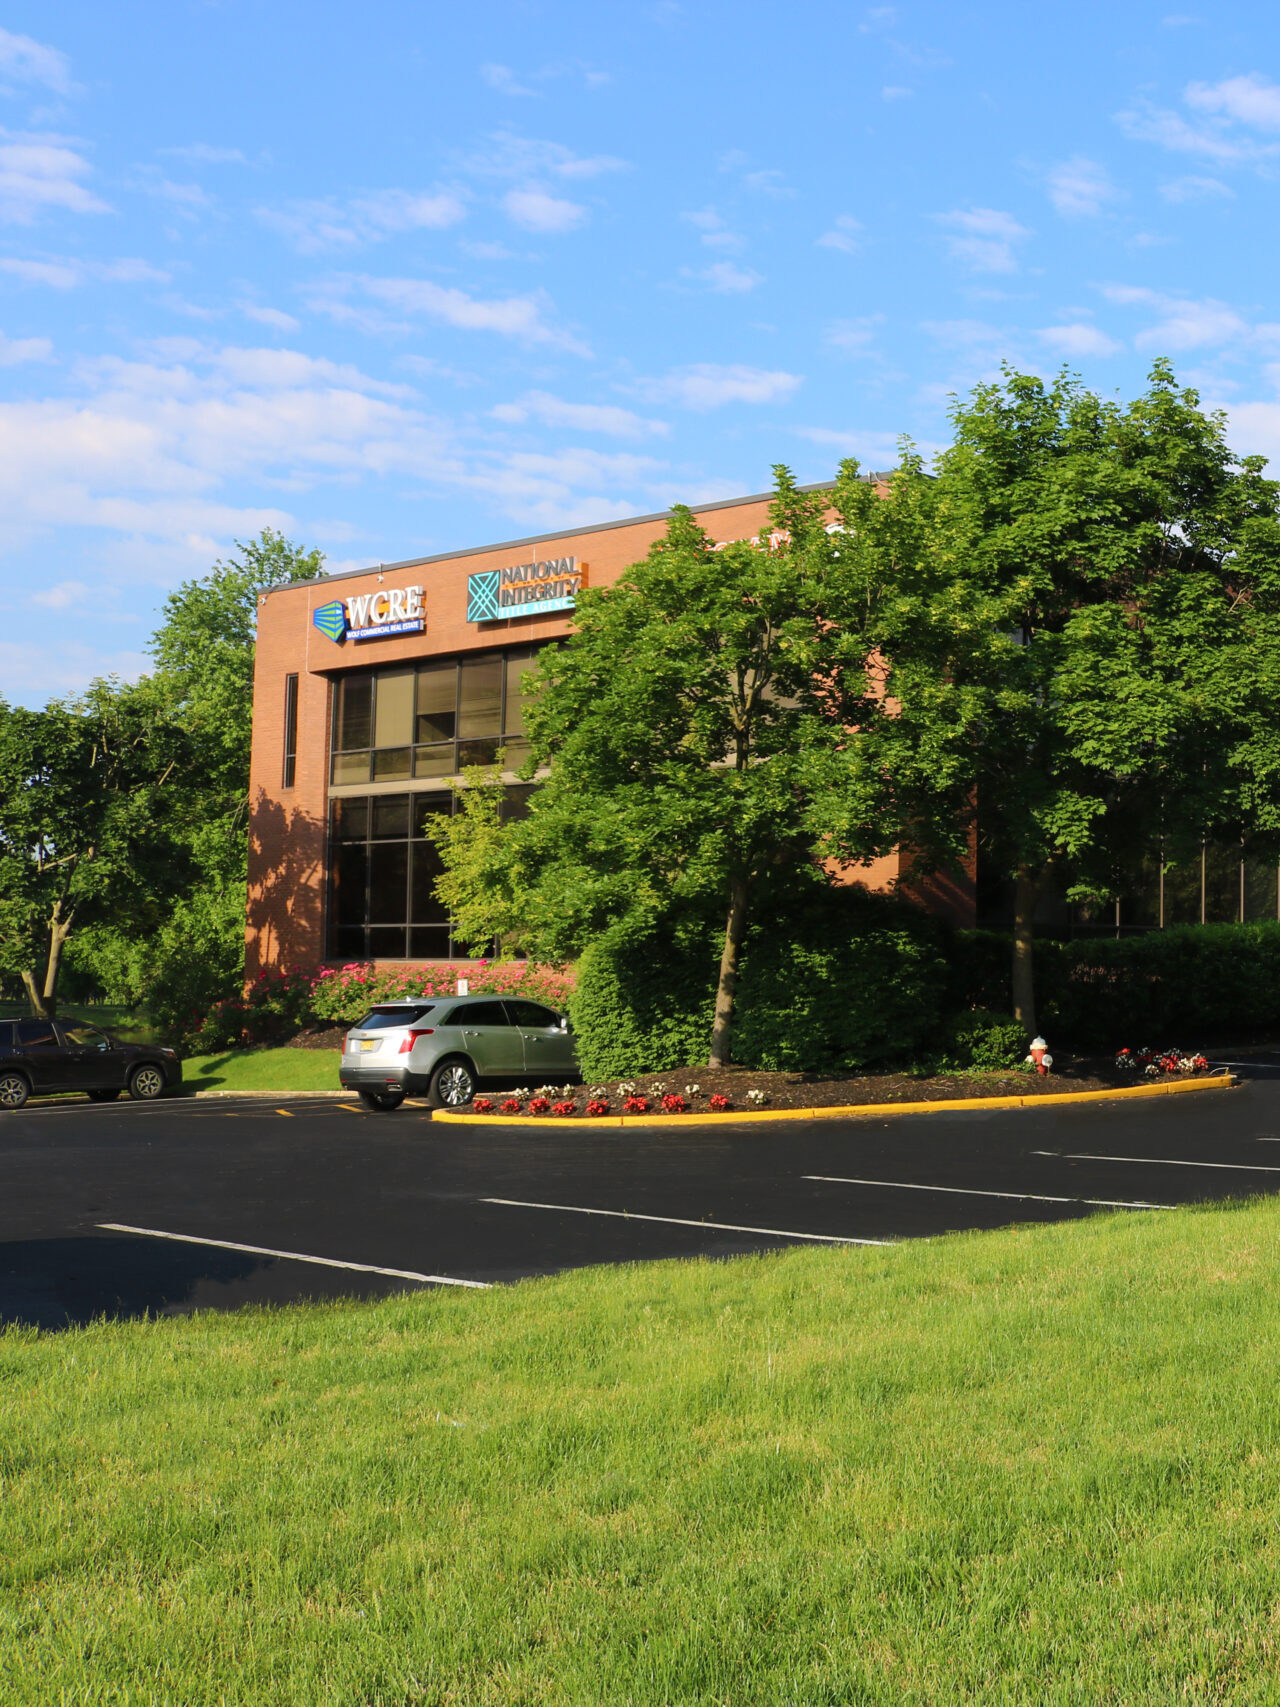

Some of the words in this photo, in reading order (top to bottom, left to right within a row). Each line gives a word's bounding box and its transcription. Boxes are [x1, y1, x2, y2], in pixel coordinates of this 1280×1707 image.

[501, 556, 582, 585] NATIONAL
[345, 585, 424, 627] WCRE
[500, 577, 581, 607] INTEGRITY
[501, 605, 528, 617] TITLE
[533, 599, 575, 611] AGENC
[360, 625, 390, 636] COMMERCIAL
[390, 622, 402, 631] REAL
[402, 620, 419, 629] ESTATE
